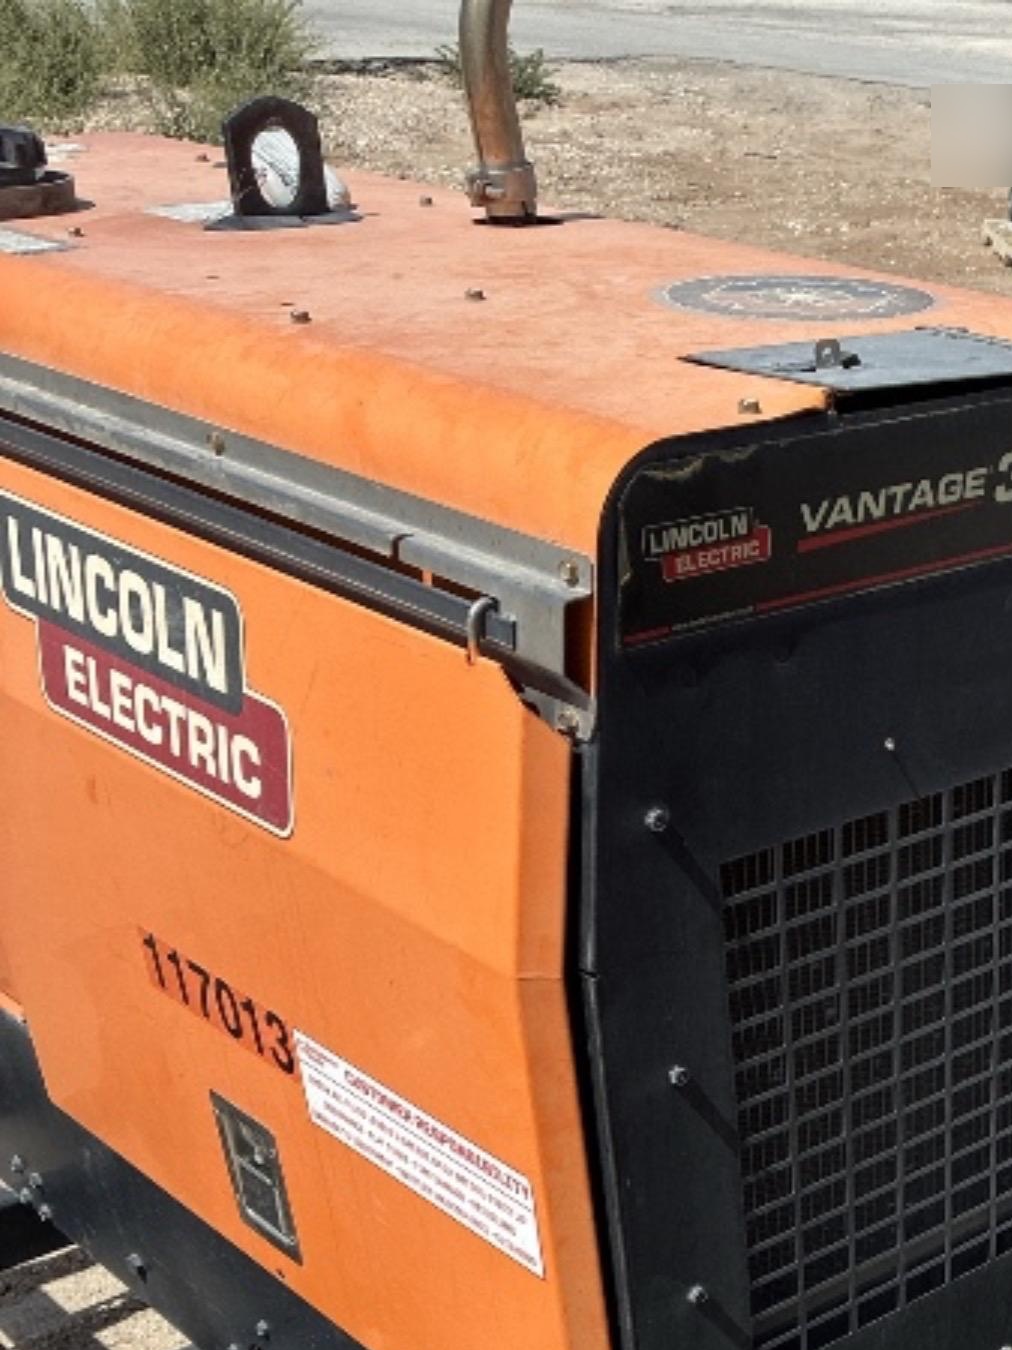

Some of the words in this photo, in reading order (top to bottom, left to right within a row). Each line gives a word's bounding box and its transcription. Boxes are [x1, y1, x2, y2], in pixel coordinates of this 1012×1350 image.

[650, 512, 749, 555] LINCOLN
[800, 467, 987, 533] VANTAGE
[7, 514, 229, 694] LINCOLN
[675, 539, 761, 574] ELECTRIC
[64, 644, 263, 799] ELECTRIC
[143, 933, 295, 1075] 117013
